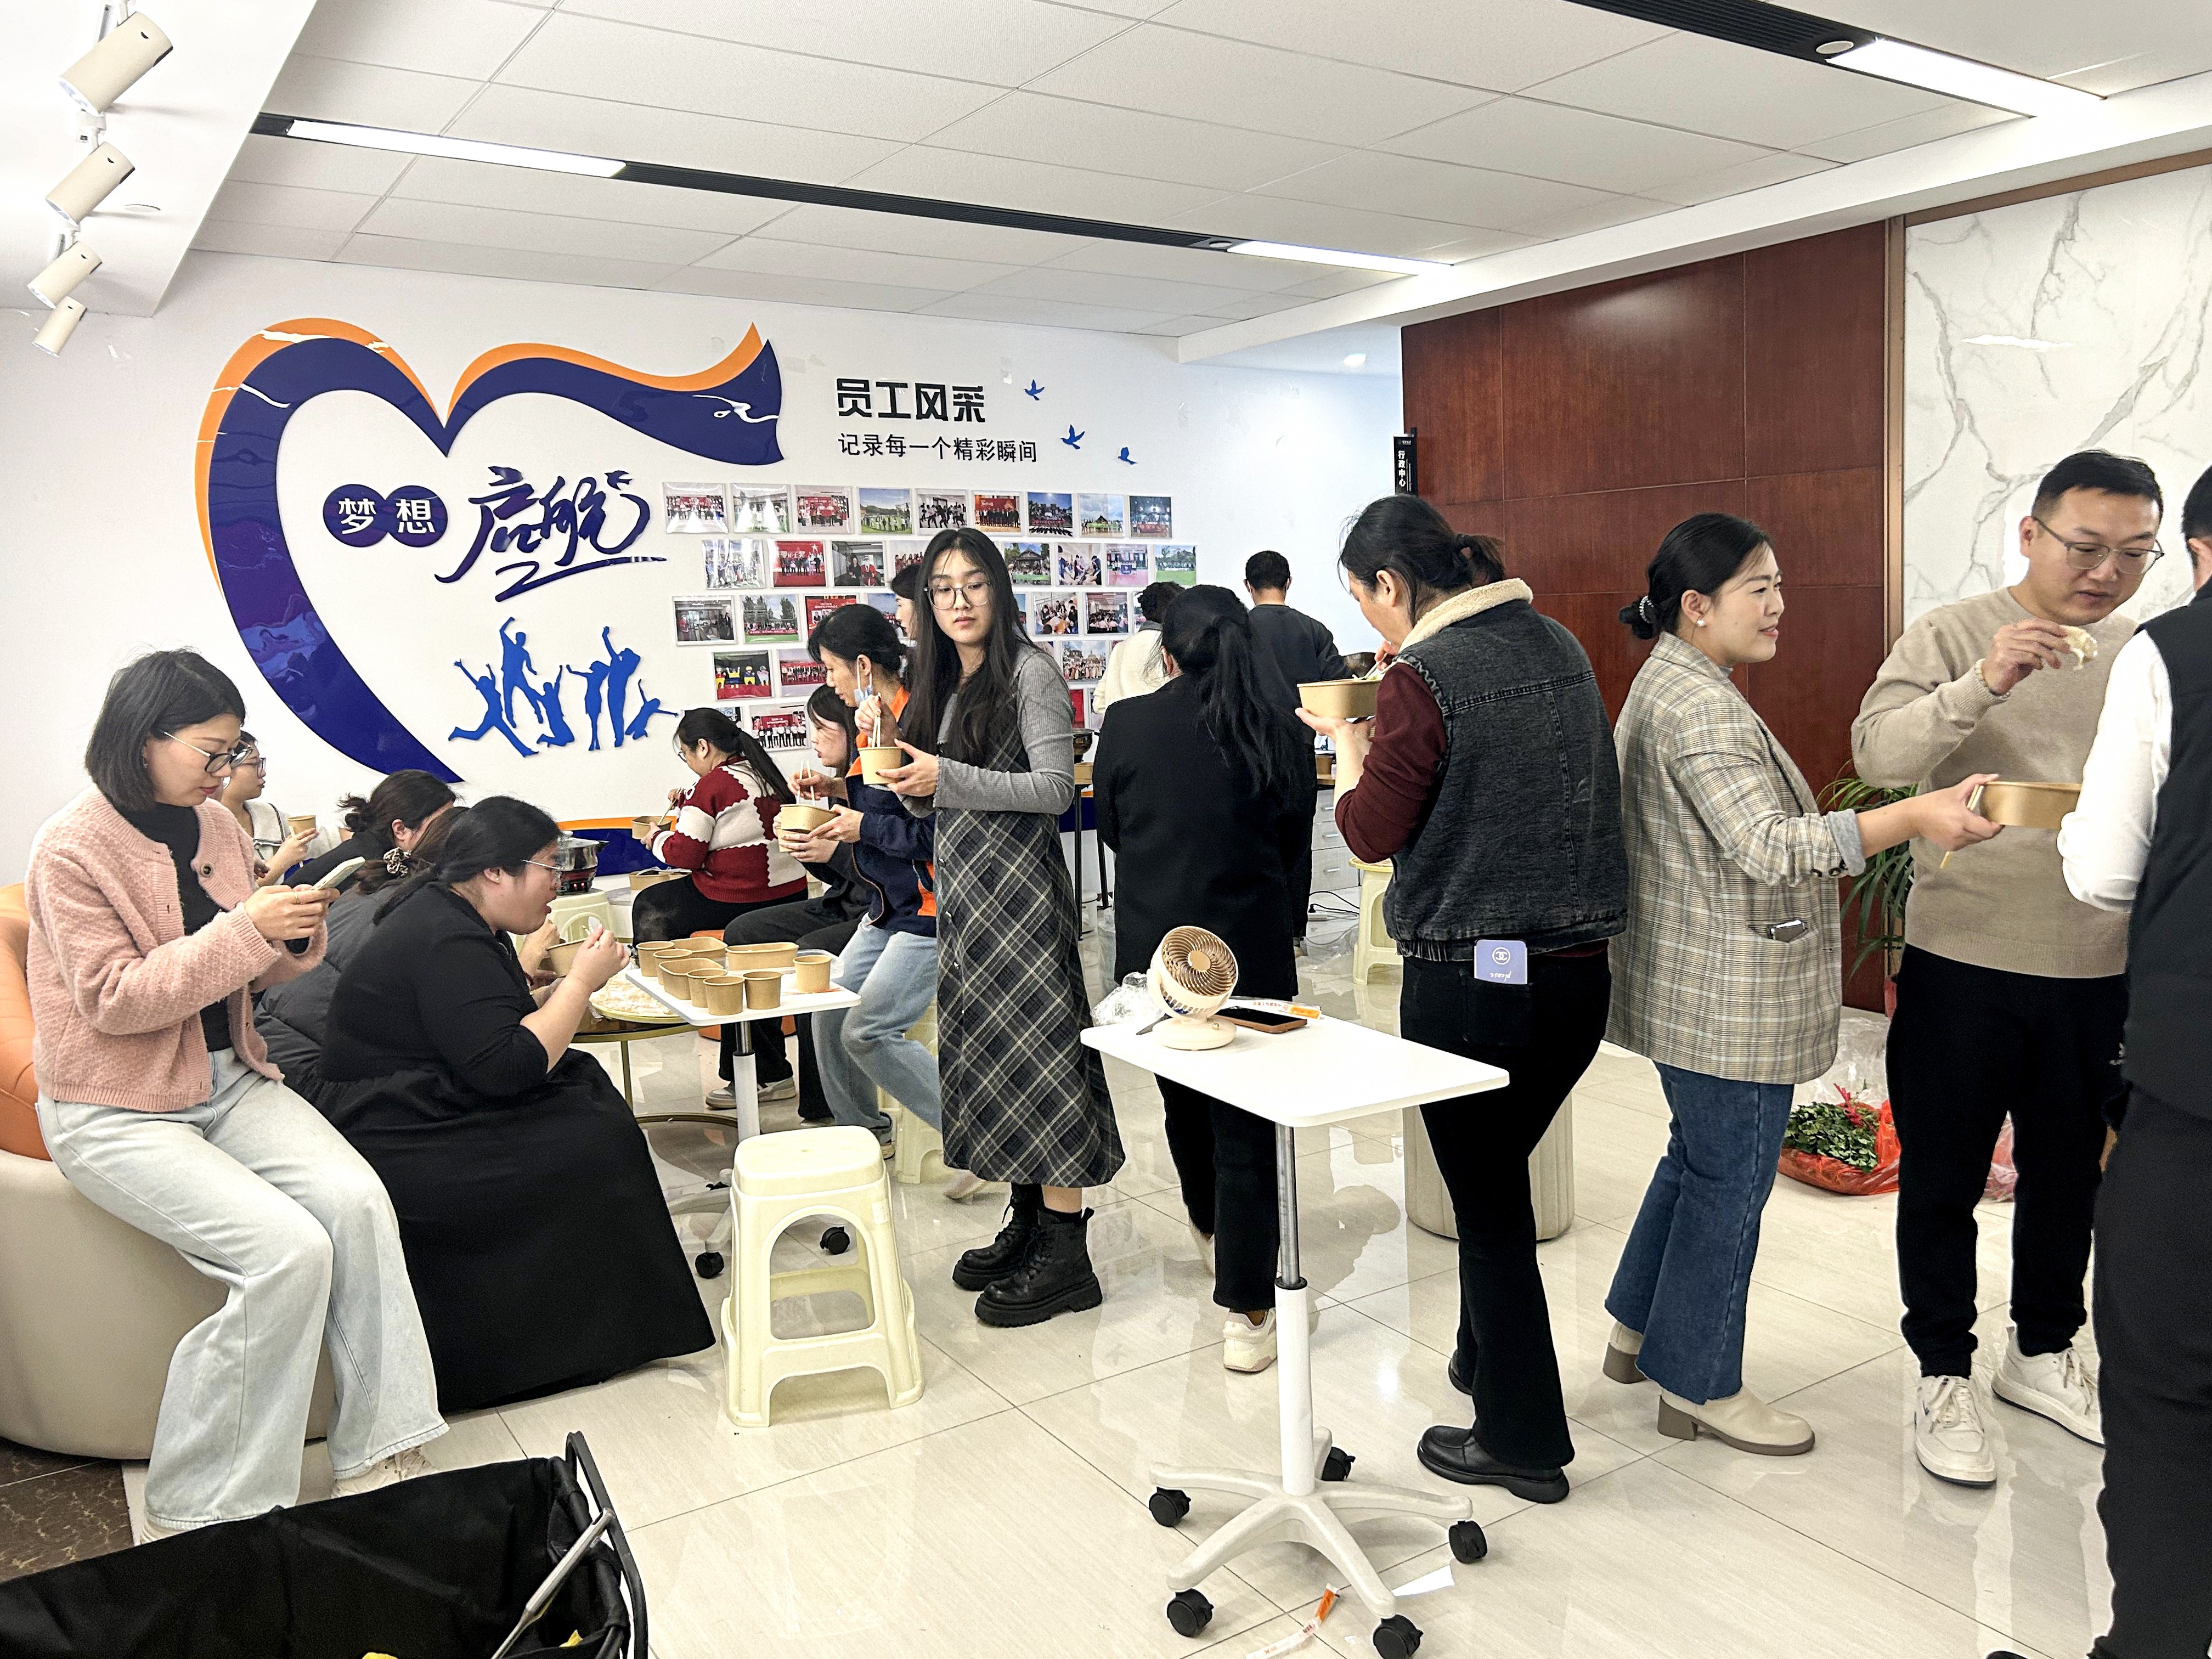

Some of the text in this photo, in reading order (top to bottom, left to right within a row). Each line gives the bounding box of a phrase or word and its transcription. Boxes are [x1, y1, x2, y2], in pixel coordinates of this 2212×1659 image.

[837, 378, 985, 422] 员工风采
[838, 433, 1036, 462] 记录每一个精彩瞬间
[1398, 450, 1406, 487] 行政中心
[1490, 970, 1512, 981] please
